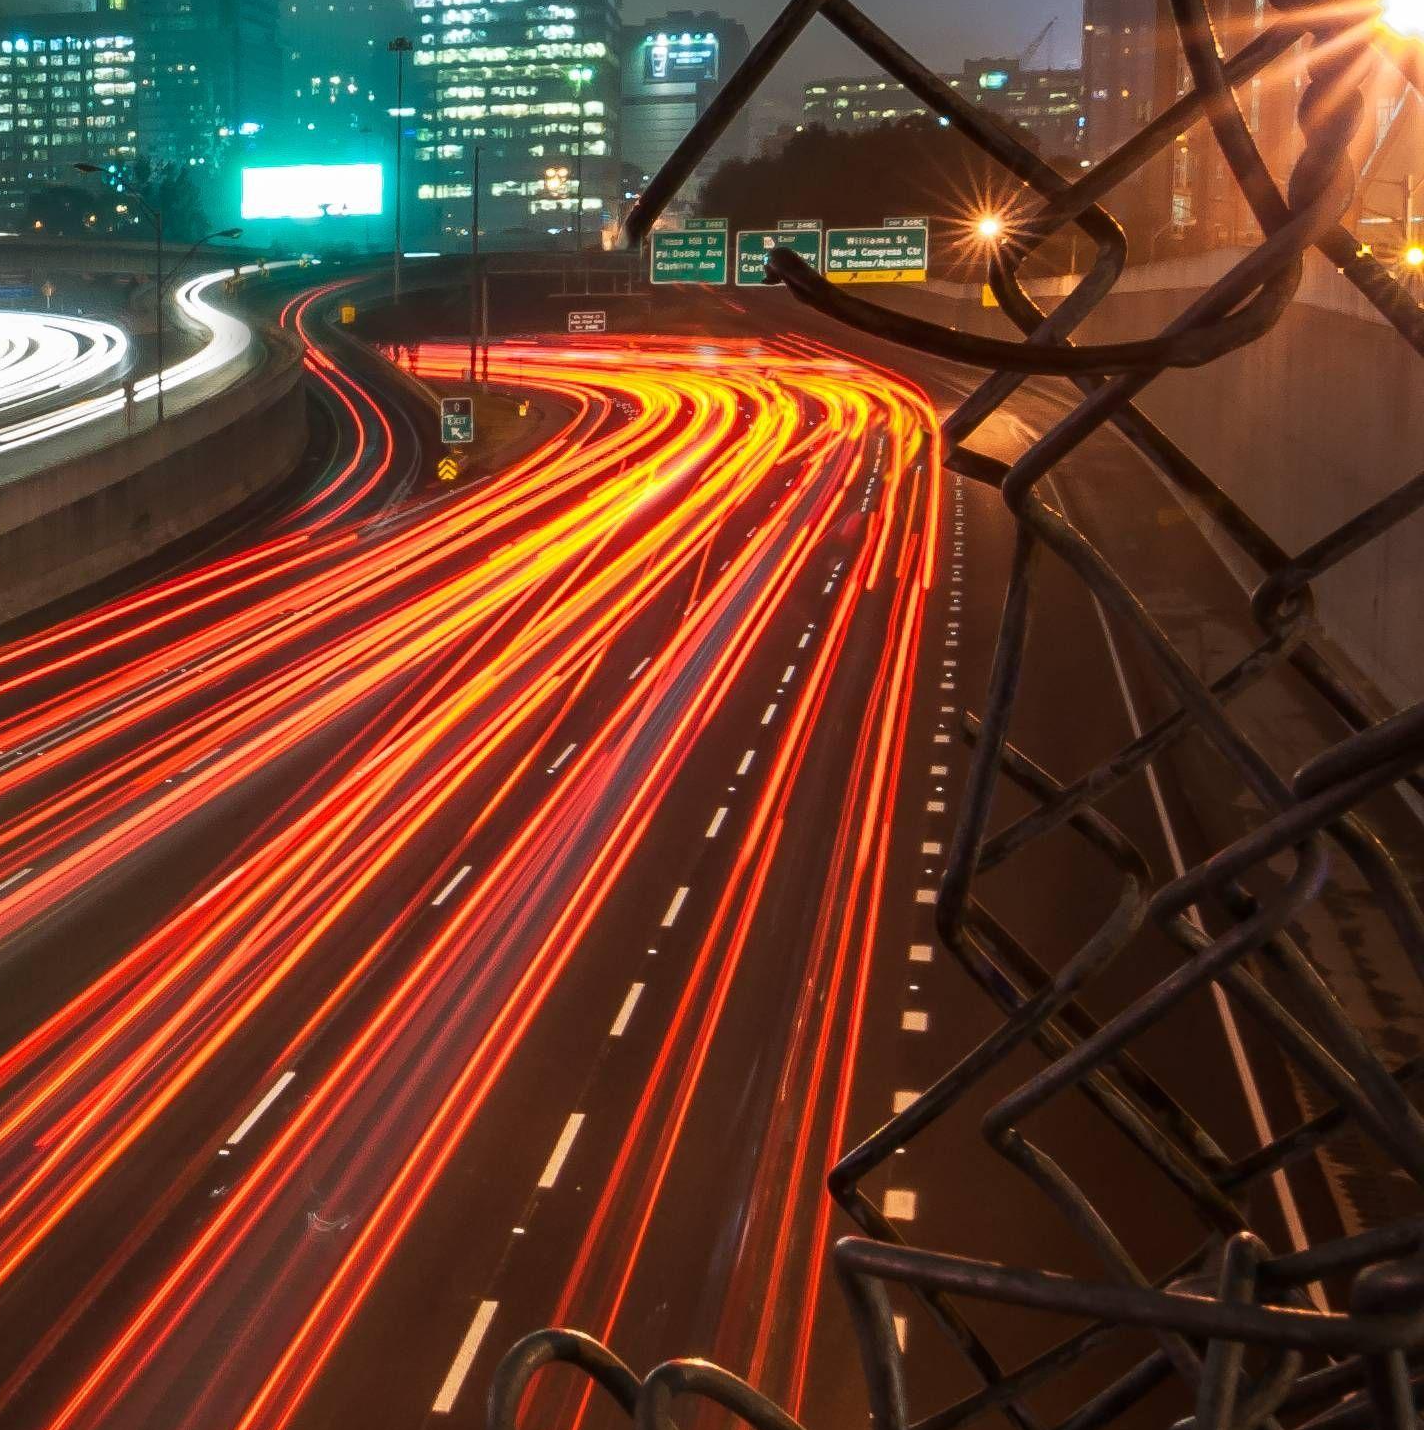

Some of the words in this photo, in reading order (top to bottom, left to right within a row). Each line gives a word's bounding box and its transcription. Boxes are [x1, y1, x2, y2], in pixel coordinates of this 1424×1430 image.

[847, 236, 891, 245] Williams
[896, 235, 908, 244] St
[831, 248, 856, 257] World
[861, 247, 902, 258] Congress
[907, 246, 922, 256] Ctr
[829, 259, 842, 269] Ga
